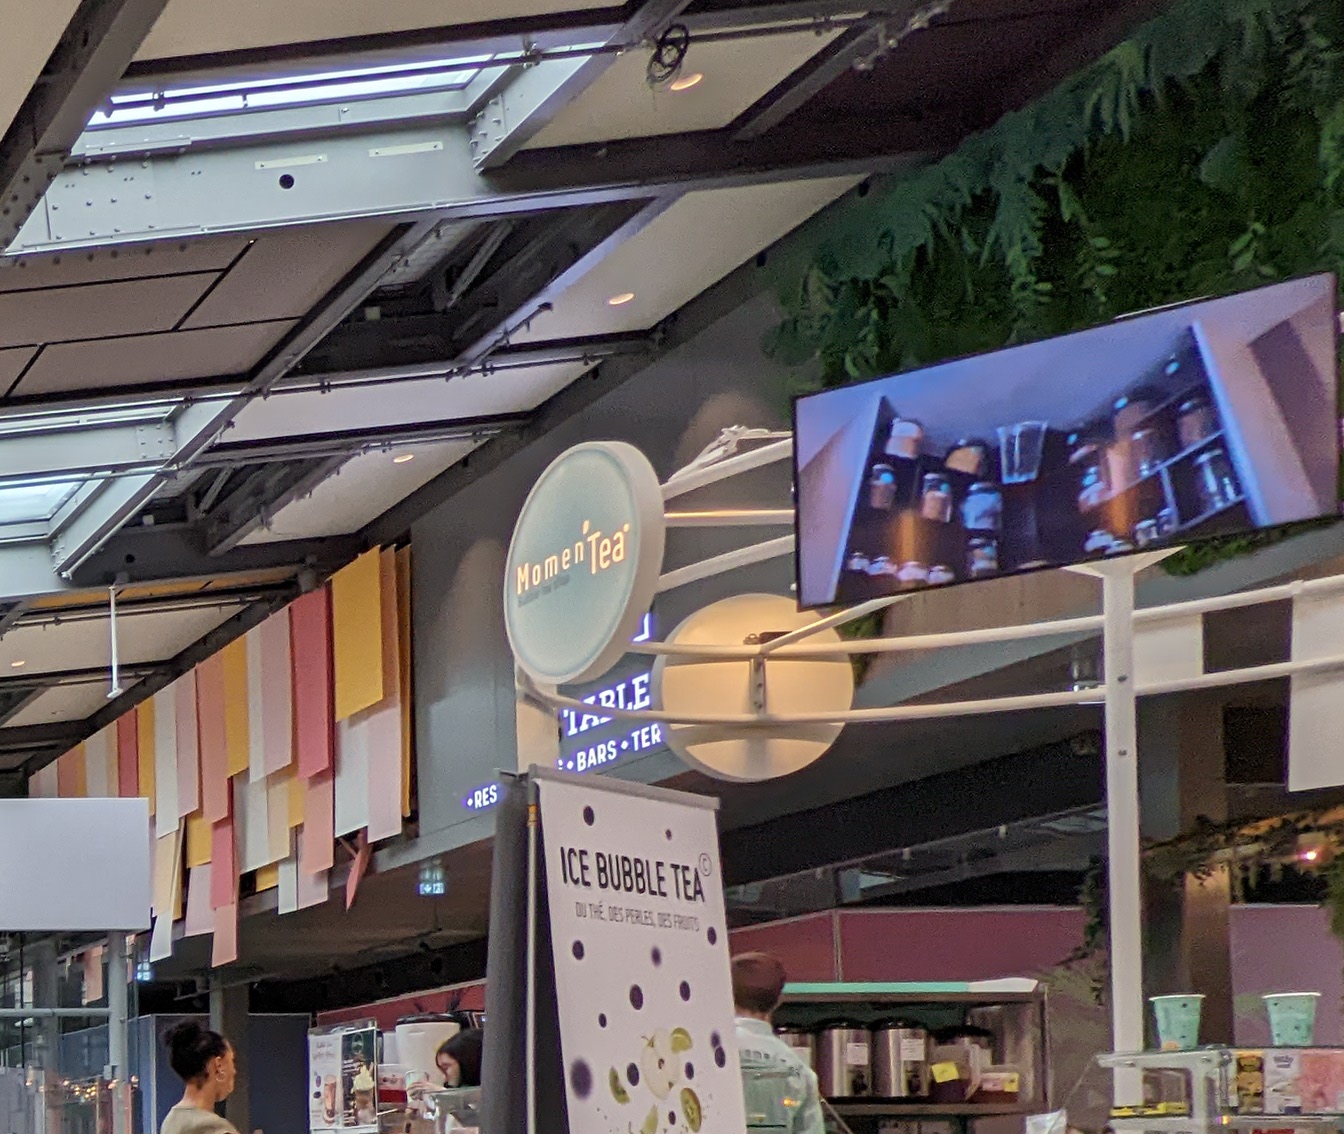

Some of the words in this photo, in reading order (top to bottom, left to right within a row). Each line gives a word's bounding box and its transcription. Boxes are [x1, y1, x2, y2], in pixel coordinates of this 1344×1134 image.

[577, 740, 617, 772] BARS
[560, 846, 591, 887] ICE
[595, 852, 667, 898] BUBBLE
[670, 863, 705, 903] TEA
